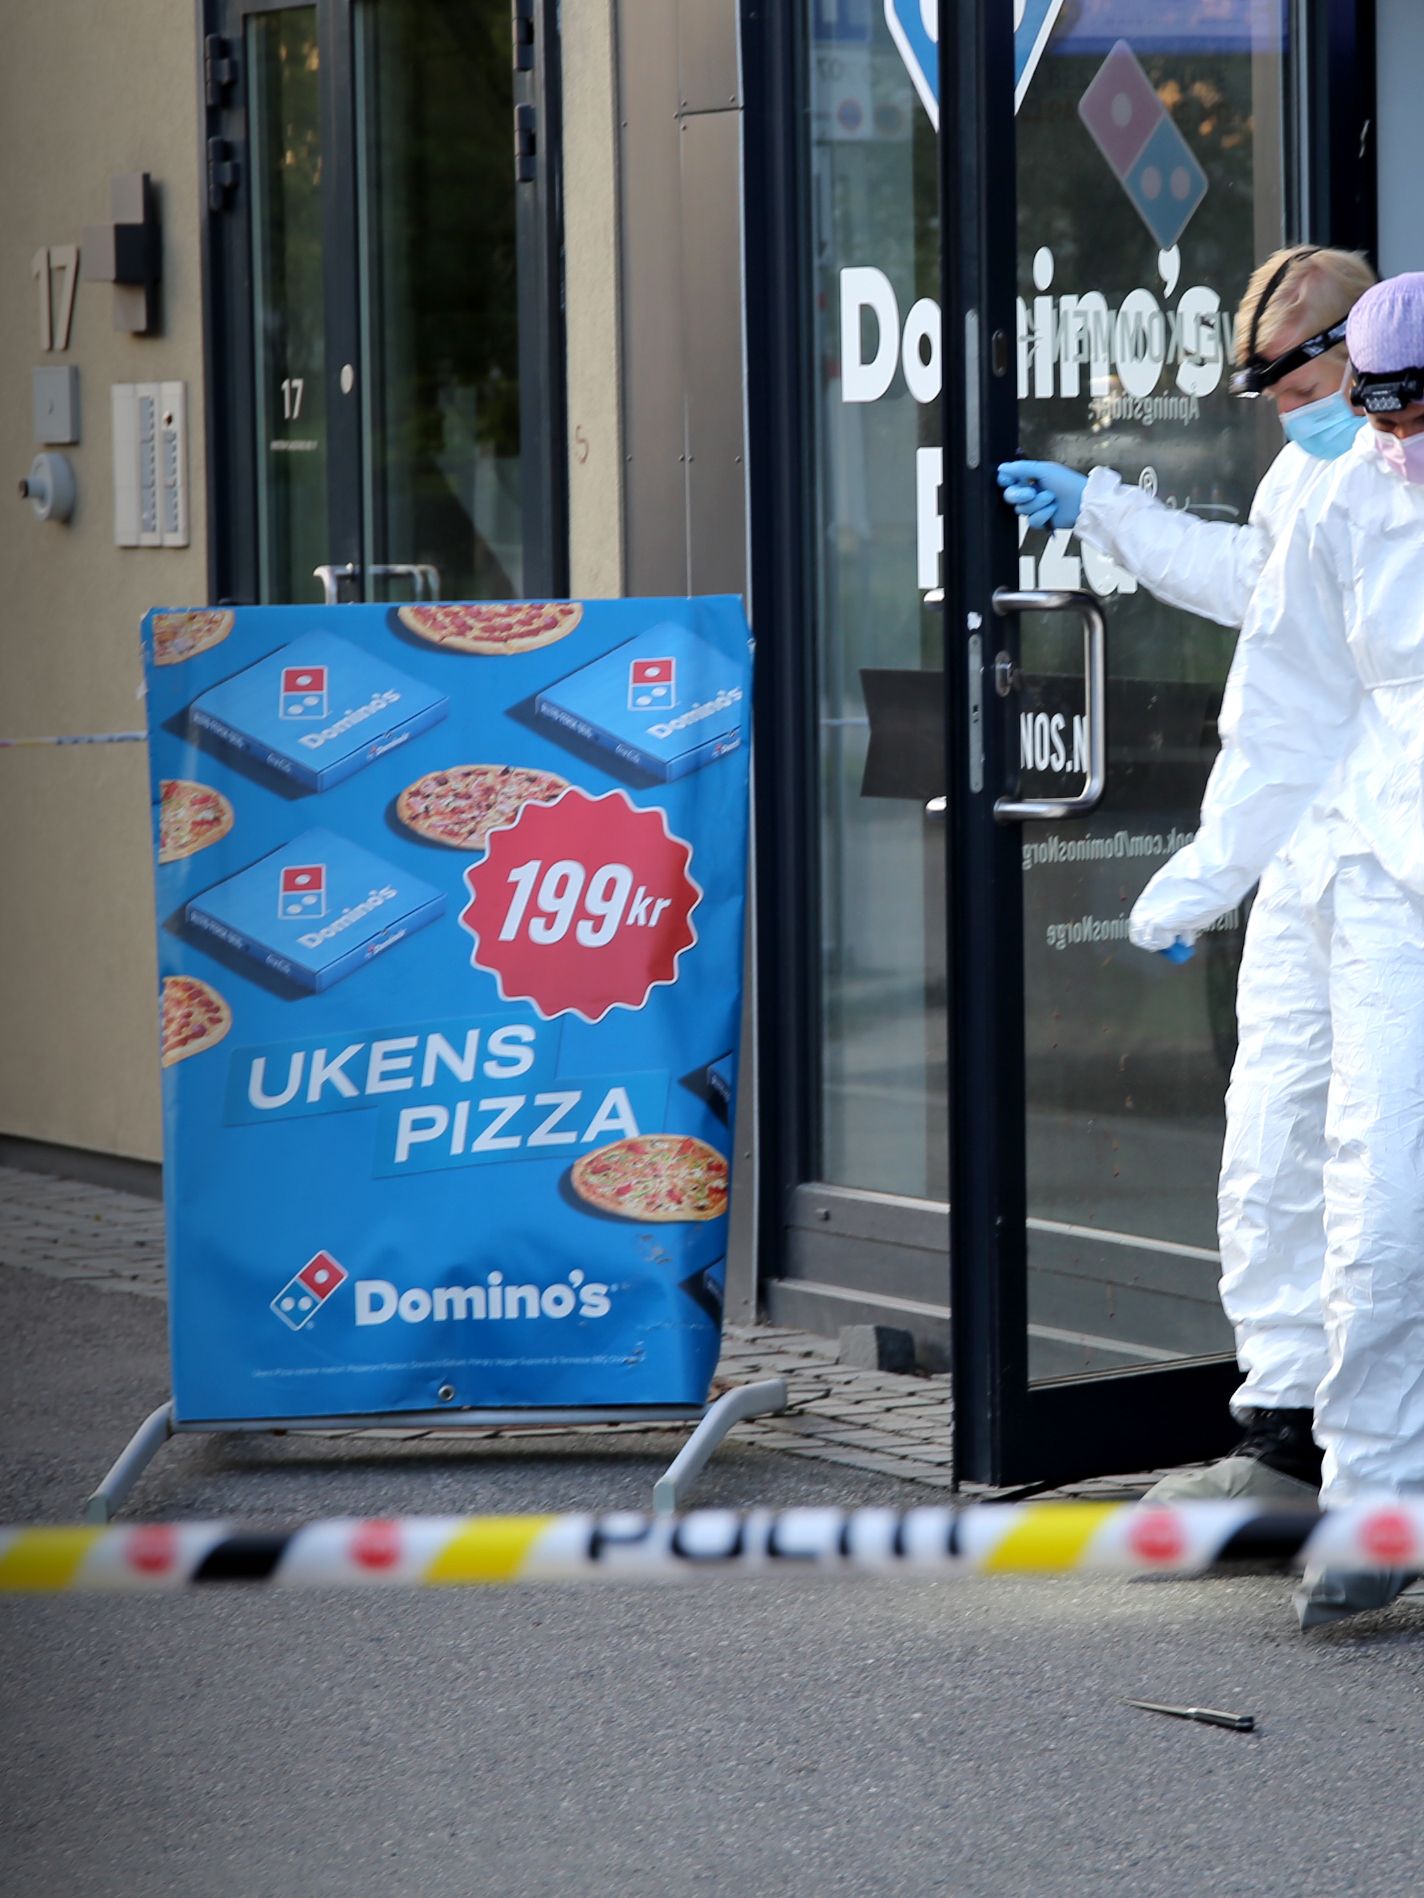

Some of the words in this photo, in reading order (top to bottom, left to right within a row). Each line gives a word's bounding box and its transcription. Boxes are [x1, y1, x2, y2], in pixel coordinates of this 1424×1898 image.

[32, 246, 79, 351] 17
[840, 245, 1223, 403] Doino's
[281, 378, 304, 419] 17
[297, 688, 401, 750] Domino's
[296, 884, 398, 949] Domino's
[248, 1024, 537, 1111] UKENS
[394, 1086, 641, 1164] PIZZA
[354, 1268, 612, 1327] Domino's
